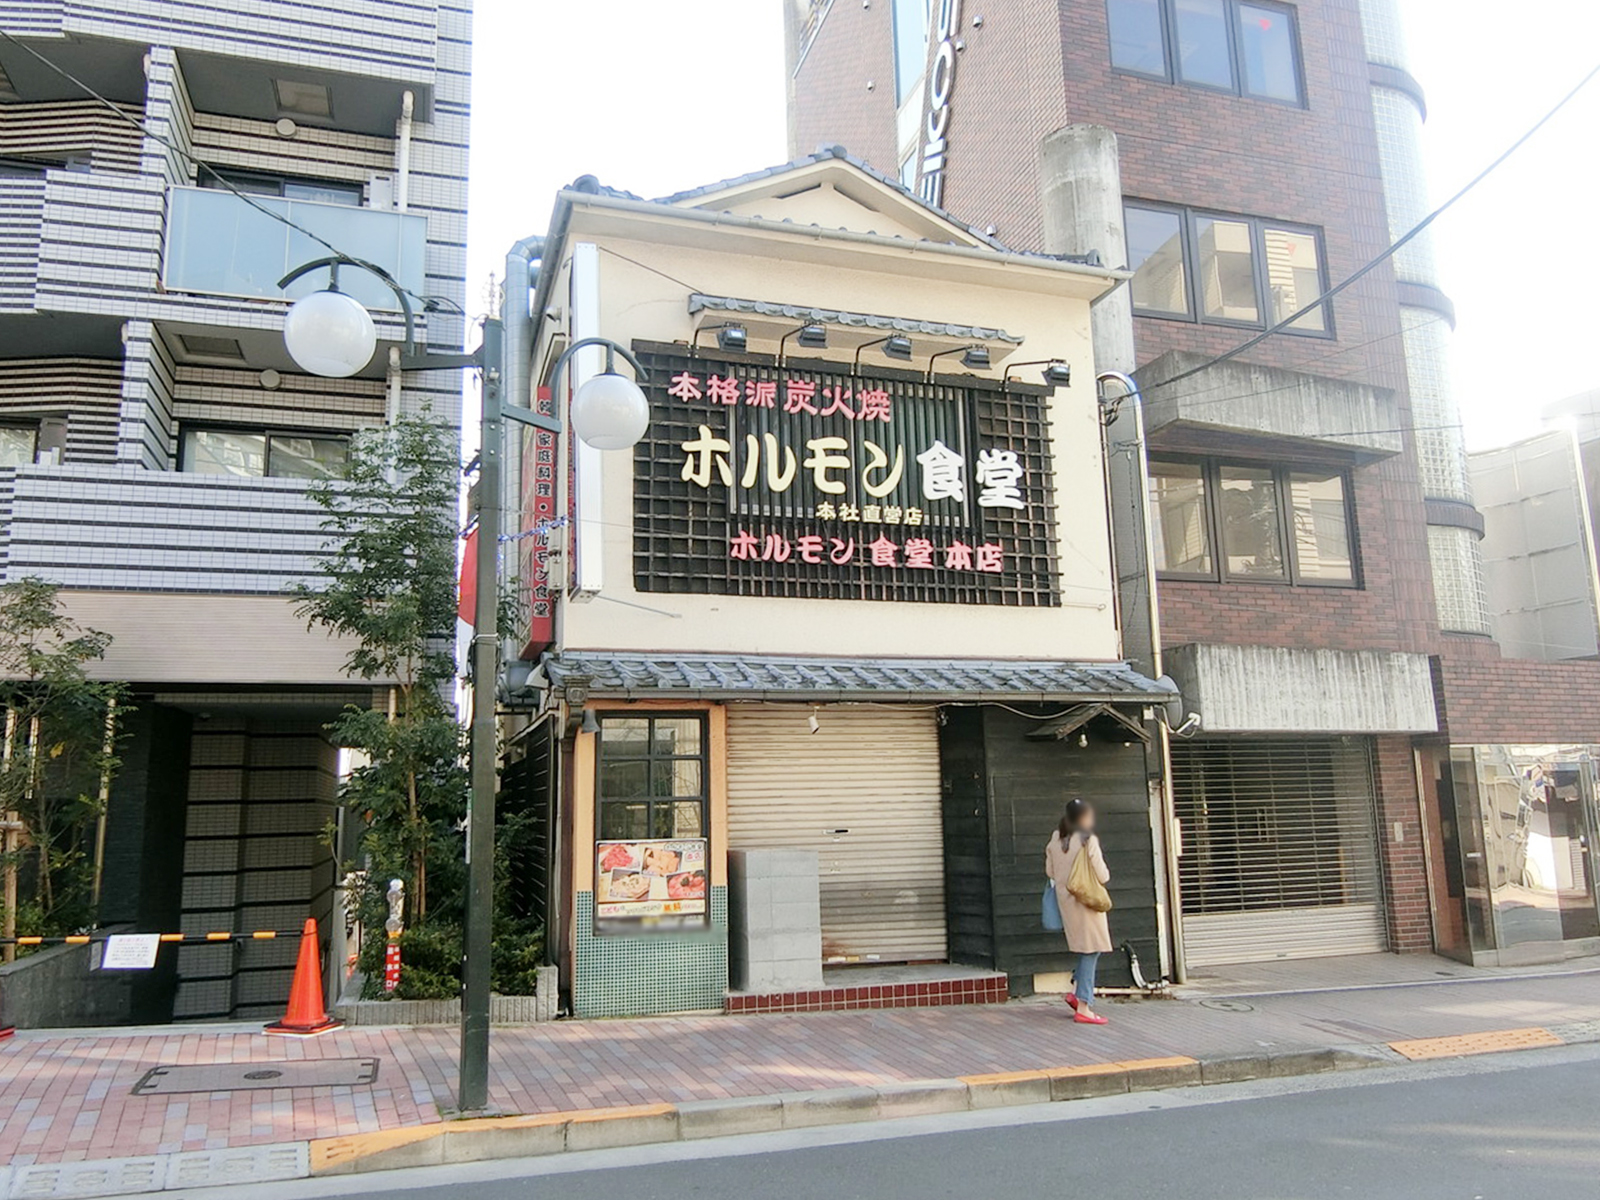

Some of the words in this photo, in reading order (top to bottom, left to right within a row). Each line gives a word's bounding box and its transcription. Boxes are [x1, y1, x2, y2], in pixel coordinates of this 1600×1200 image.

[681, 424, 1026, 510] ホルモン食堂
